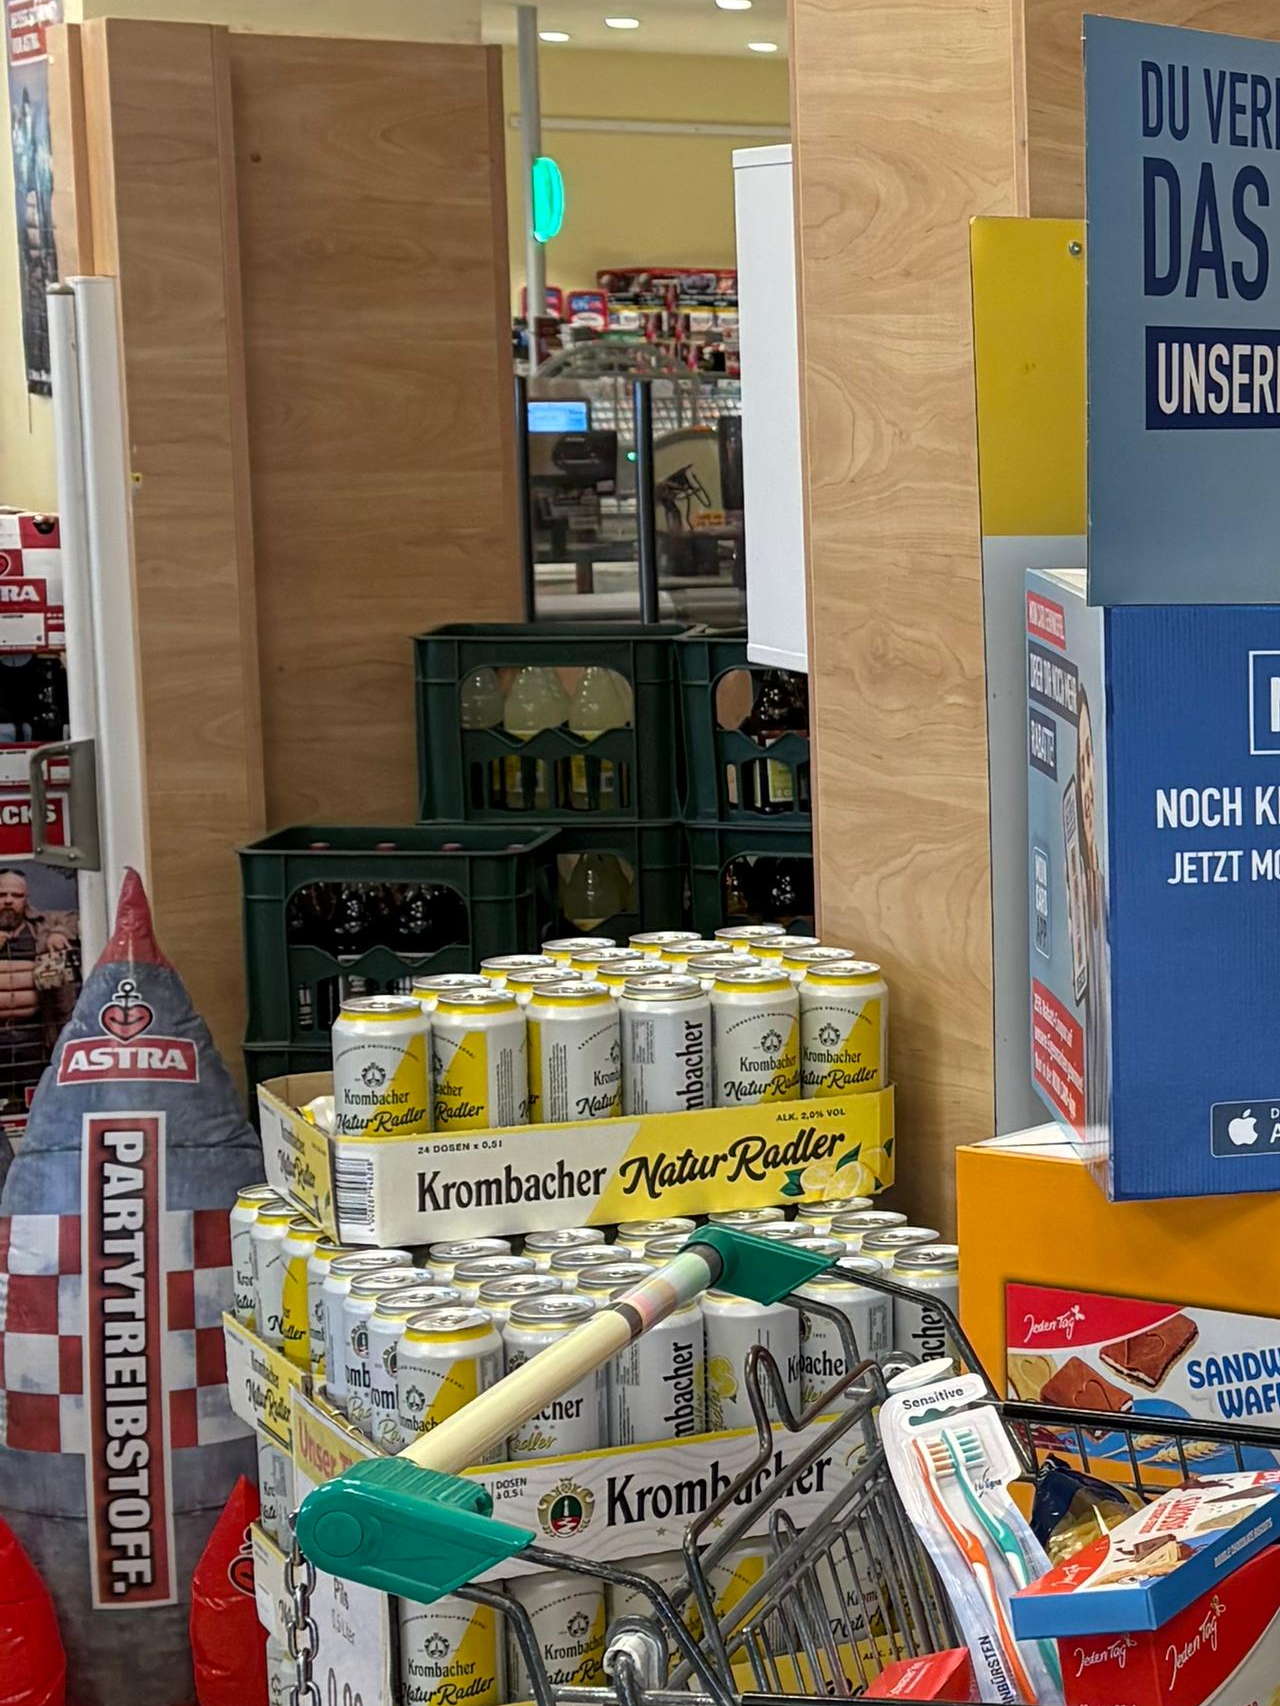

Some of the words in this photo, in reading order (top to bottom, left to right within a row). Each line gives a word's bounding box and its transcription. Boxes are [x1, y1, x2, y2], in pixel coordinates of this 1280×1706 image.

[1141, 60, 1189, 141] DU
[1144, 156, 1270, 301] DAS
[1155, 788, 1242, 828] NOCH
[1167, 850, 1243, 885] JETZT
[67, 1046, 189, 1073] ASTRA
[677, 1020, 704, 1110] mbacher
[803, 1050, 863, 1065] Krombacher
[344, 1088, 410, 1106] Krombacher
[776, 1112, 798, 1122] ALK.
[800, 1109, 824, 1121] 2,0%
[827, 1107, 846, 1118] VOL
[418, 1146, 430, 1155] 24
[433, 1143, 470, 1153] DOSEN
[417, 1159, 607, 1213] Krombacher
[1023, 1313, 1058, 1342] Jeden
[1057, 1308, 1075, 1341] Tag
[102, 1129, 152, 1594] PARTYTREIBSTOFF.
[663, 1342, 693, 1437] mbacher
[903, 1387, 964, 1411] Sensitive
[299, 1417, 336, 1479] Unser
[496, 1477, 527, 1490] DOSEN
[407, 1658, 476, 1677] Krombacher
[1074, 1647, 1108, 1678] Jeden
[1107, 1639, 1128, 1670] Tag
[1166, 1634, 1201, 1691] Jeden
[1198, 1609, 1219, 1652] Tag
